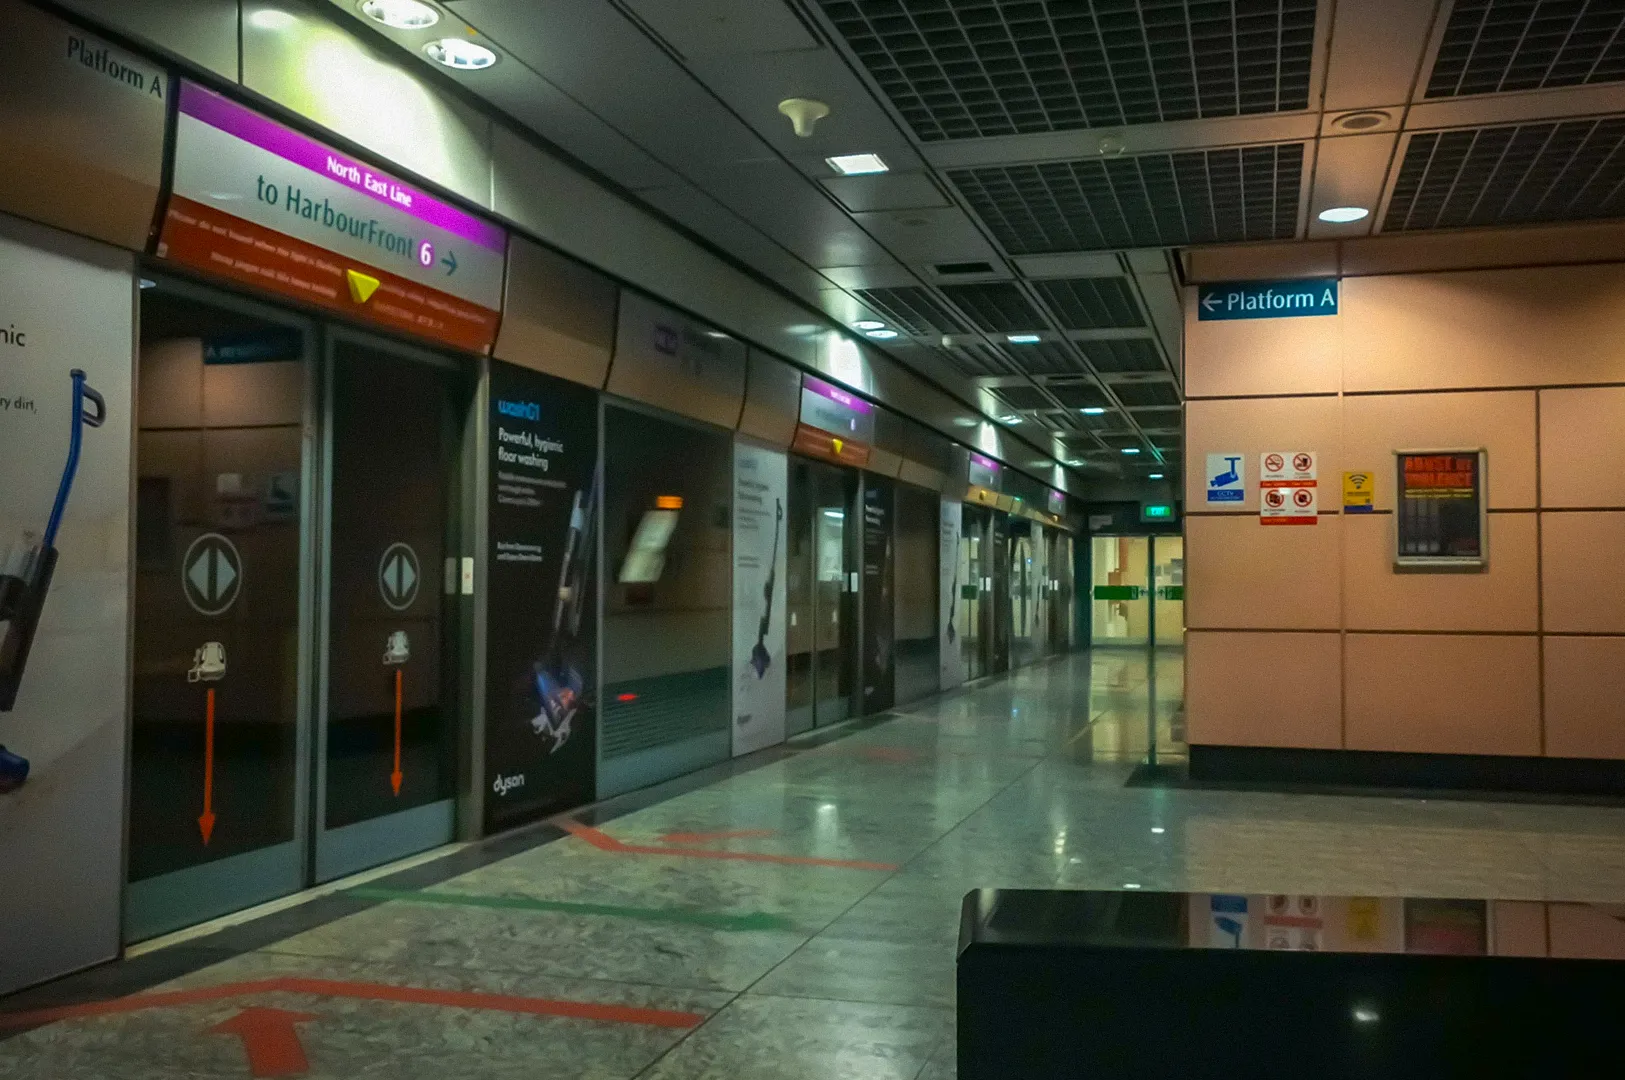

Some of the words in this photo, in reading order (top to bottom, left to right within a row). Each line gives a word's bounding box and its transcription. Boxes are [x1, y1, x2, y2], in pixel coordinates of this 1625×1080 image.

[67, 35, 143, 90] Platform
[149, 76, 162, 98] A
[327, 155, 360, 184] North
[364, 174, 387, 197] East
[390, 185, 412, 208] Line
[257, 174, 278, 205] to
[286, 185, 413, 259] HarbourFront
[420, 242, 431, 265] 6
[1228, 289, 1314, 311] Platform
[1320, 288, 1335, 307] A
[518, 453, 549, 472] washing
[493, 773, 525, 796] dyson
